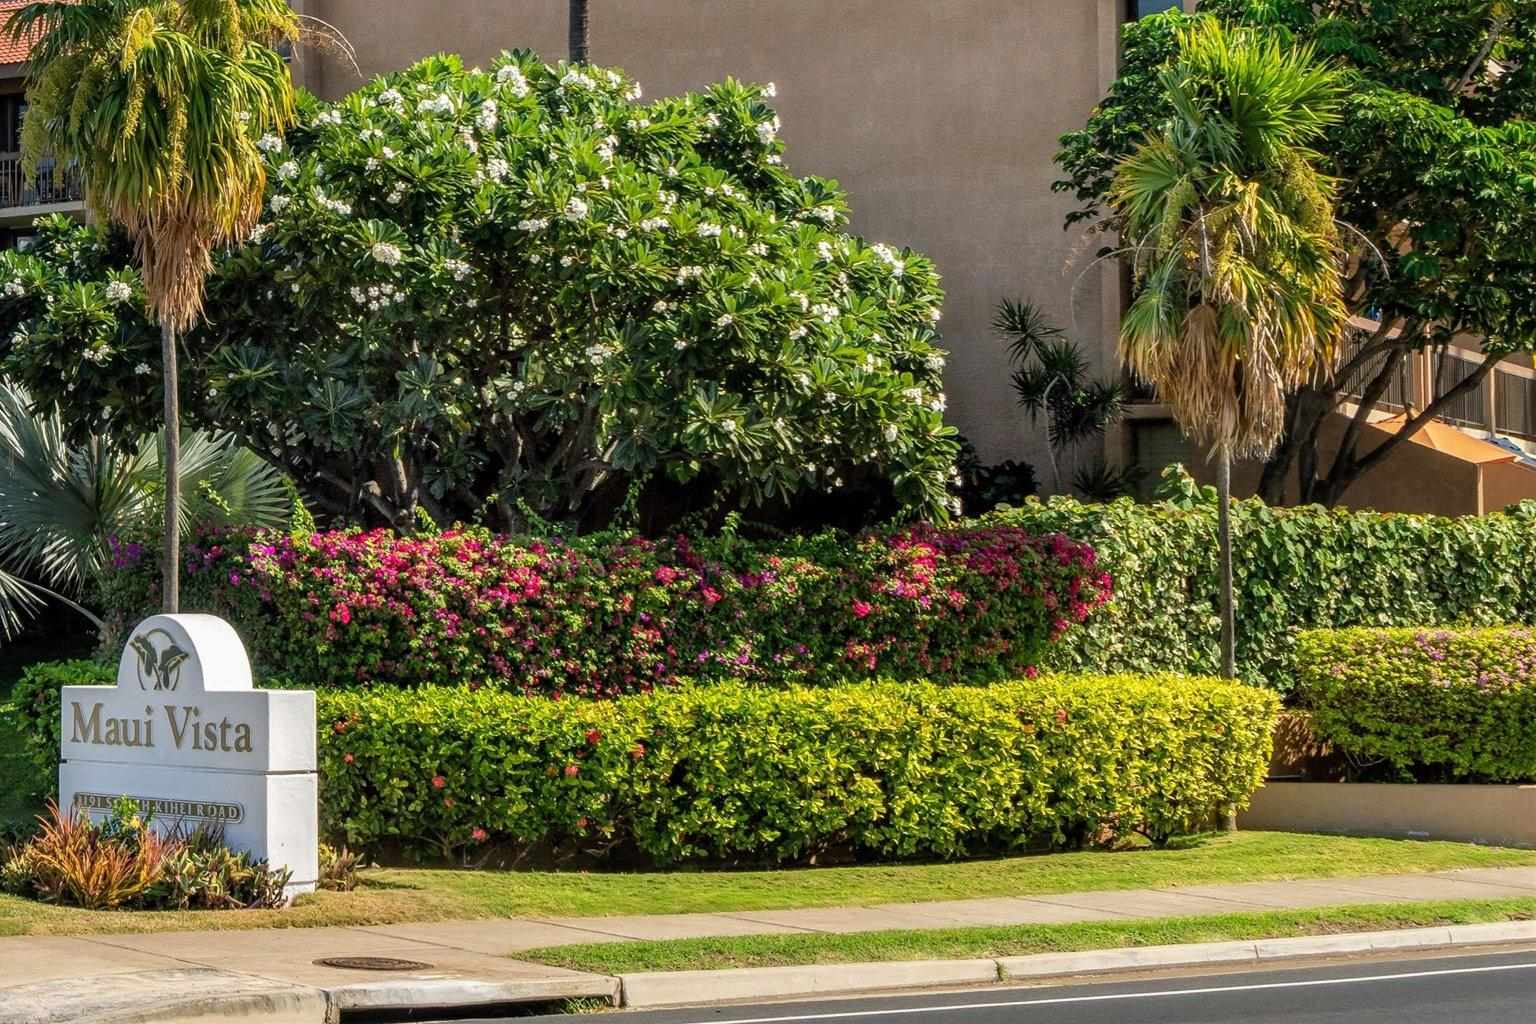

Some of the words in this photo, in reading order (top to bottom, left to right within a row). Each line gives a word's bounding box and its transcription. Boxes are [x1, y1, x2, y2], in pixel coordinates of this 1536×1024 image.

[70, 701, 155, 748] Maui
[164, 704, 253, 753] Vista
[155, 799, 193, 815] KIHEI
[196, 803, 237, 819] ROAD
